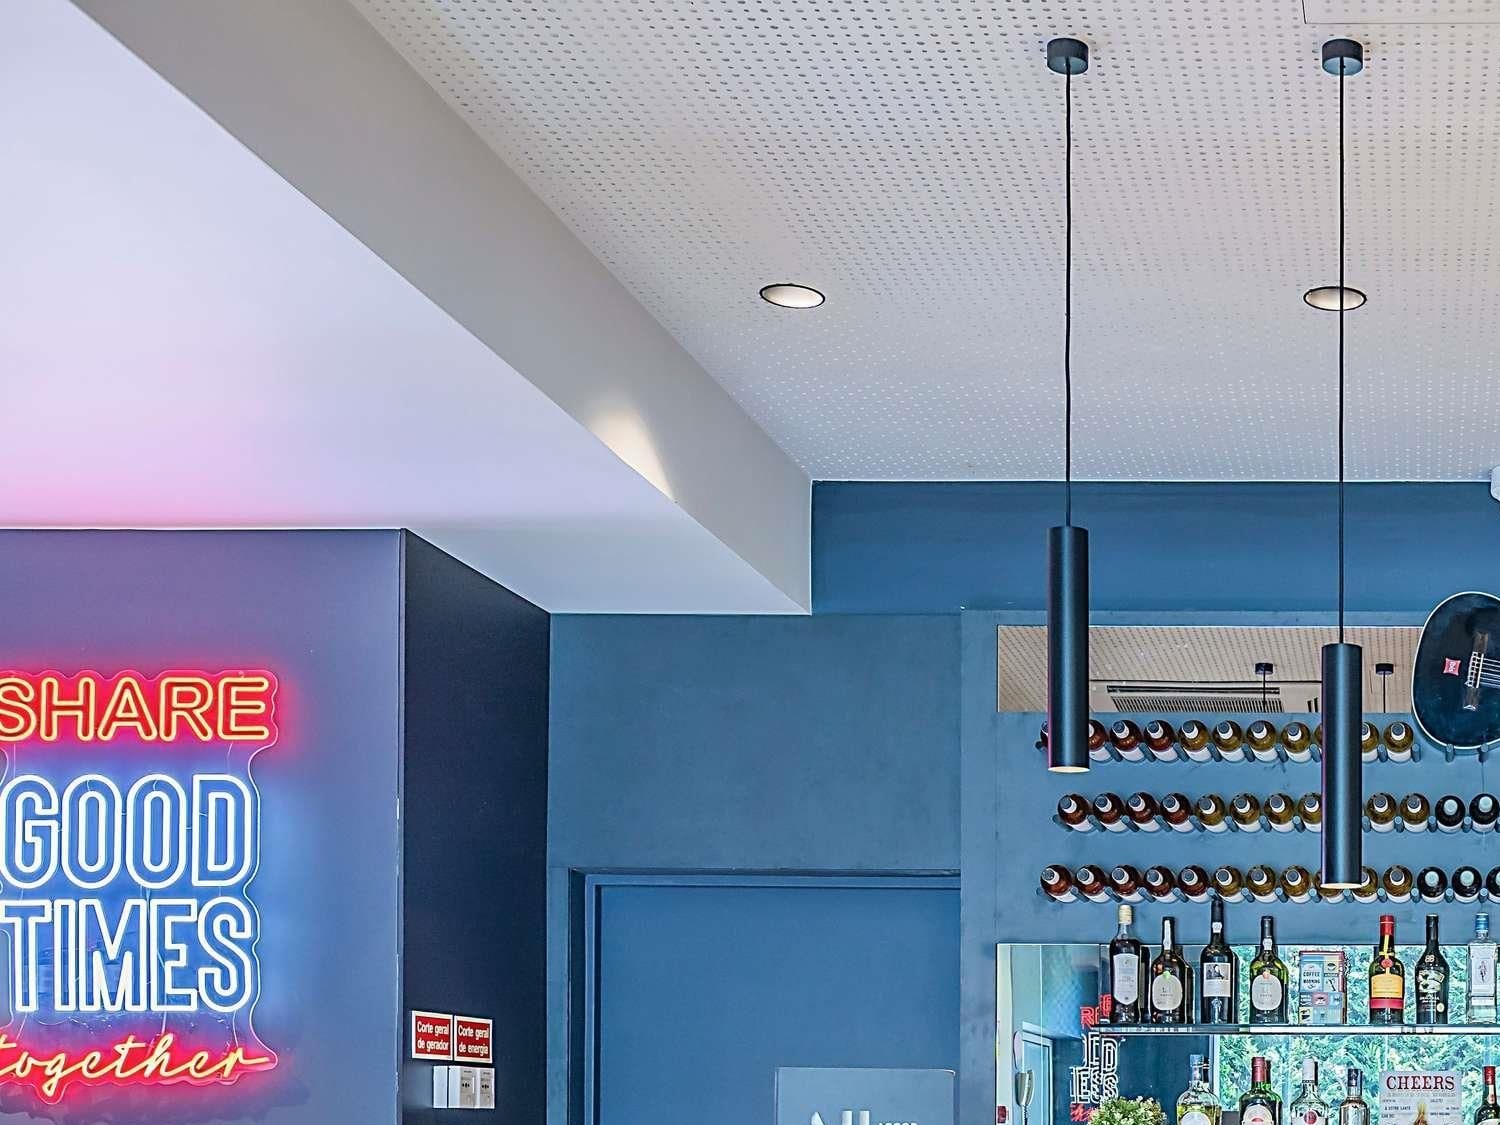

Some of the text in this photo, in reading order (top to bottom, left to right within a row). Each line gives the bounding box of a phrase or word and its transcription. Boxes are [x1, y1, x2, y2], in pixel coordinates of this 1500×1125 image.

[0, 676, 271, 742] SHARE
[0, 774, 255, 888] GOOD
[0, 898, 254, 1013] TIMES
[417, 1021, 450, 1036] Corte geral
[458, 1025, 490, 1040] Corte geral
[417, 1038, 449, 1052] de gerador
[459, 1042, 489, 1056] de energia
[0, 1034, 272, 1103] together
[1386, 1075, 1455, 1090] CHEERS
